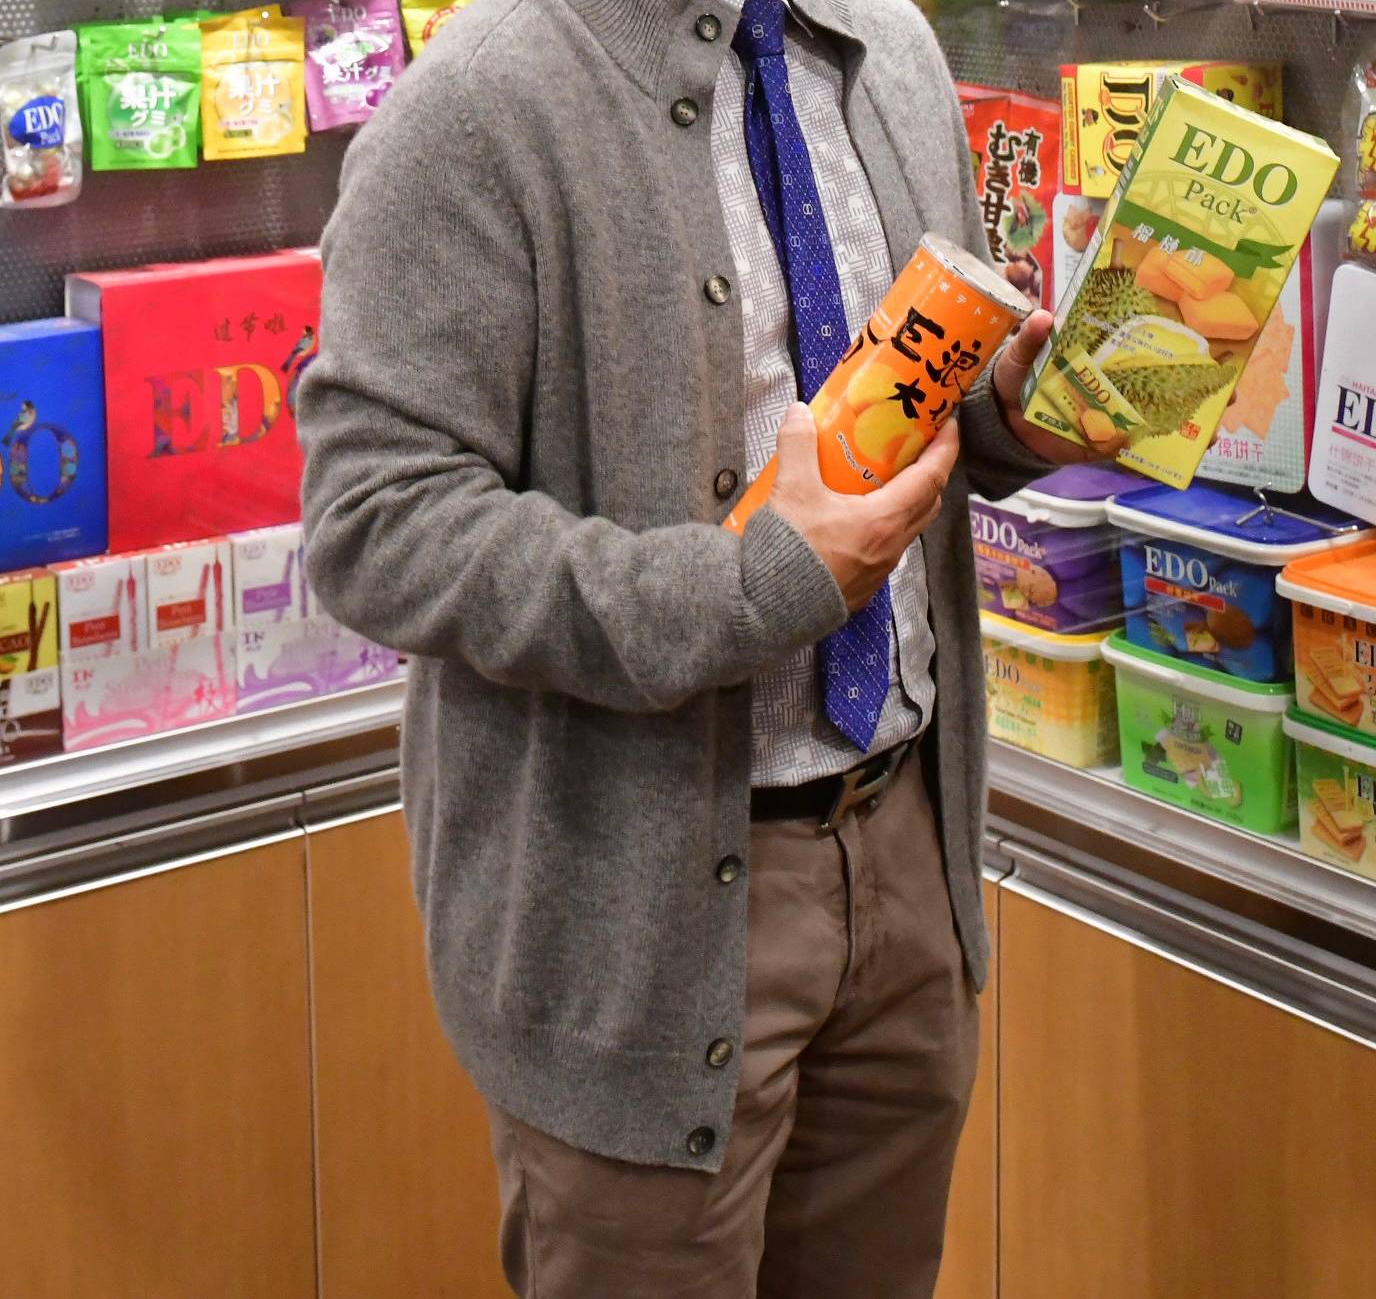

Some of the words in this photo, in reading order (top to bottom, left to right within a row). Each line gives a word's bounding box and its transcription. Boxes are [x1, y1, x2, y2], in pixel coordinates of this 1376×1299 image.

[328, 5, 367, 22] EDO
[127, 41, 169, 59] EDO
[120, 79, 177, 111] 果汁
[131, 111, 166, 129] グミ
[1018, 127, 1042, 187] 有機
[1169, 121, 1298, 206] EDO
[1075, 364, 1111, 405] EDO
[1209, 439, 1264, 463] 锦饼干
[969, 512, 1018, 551] EDO
[1143, 544, 1208, 588] EDO
[1209, 575, 1238, 598] Pack
[983, 653, 1020, 684] EDO
